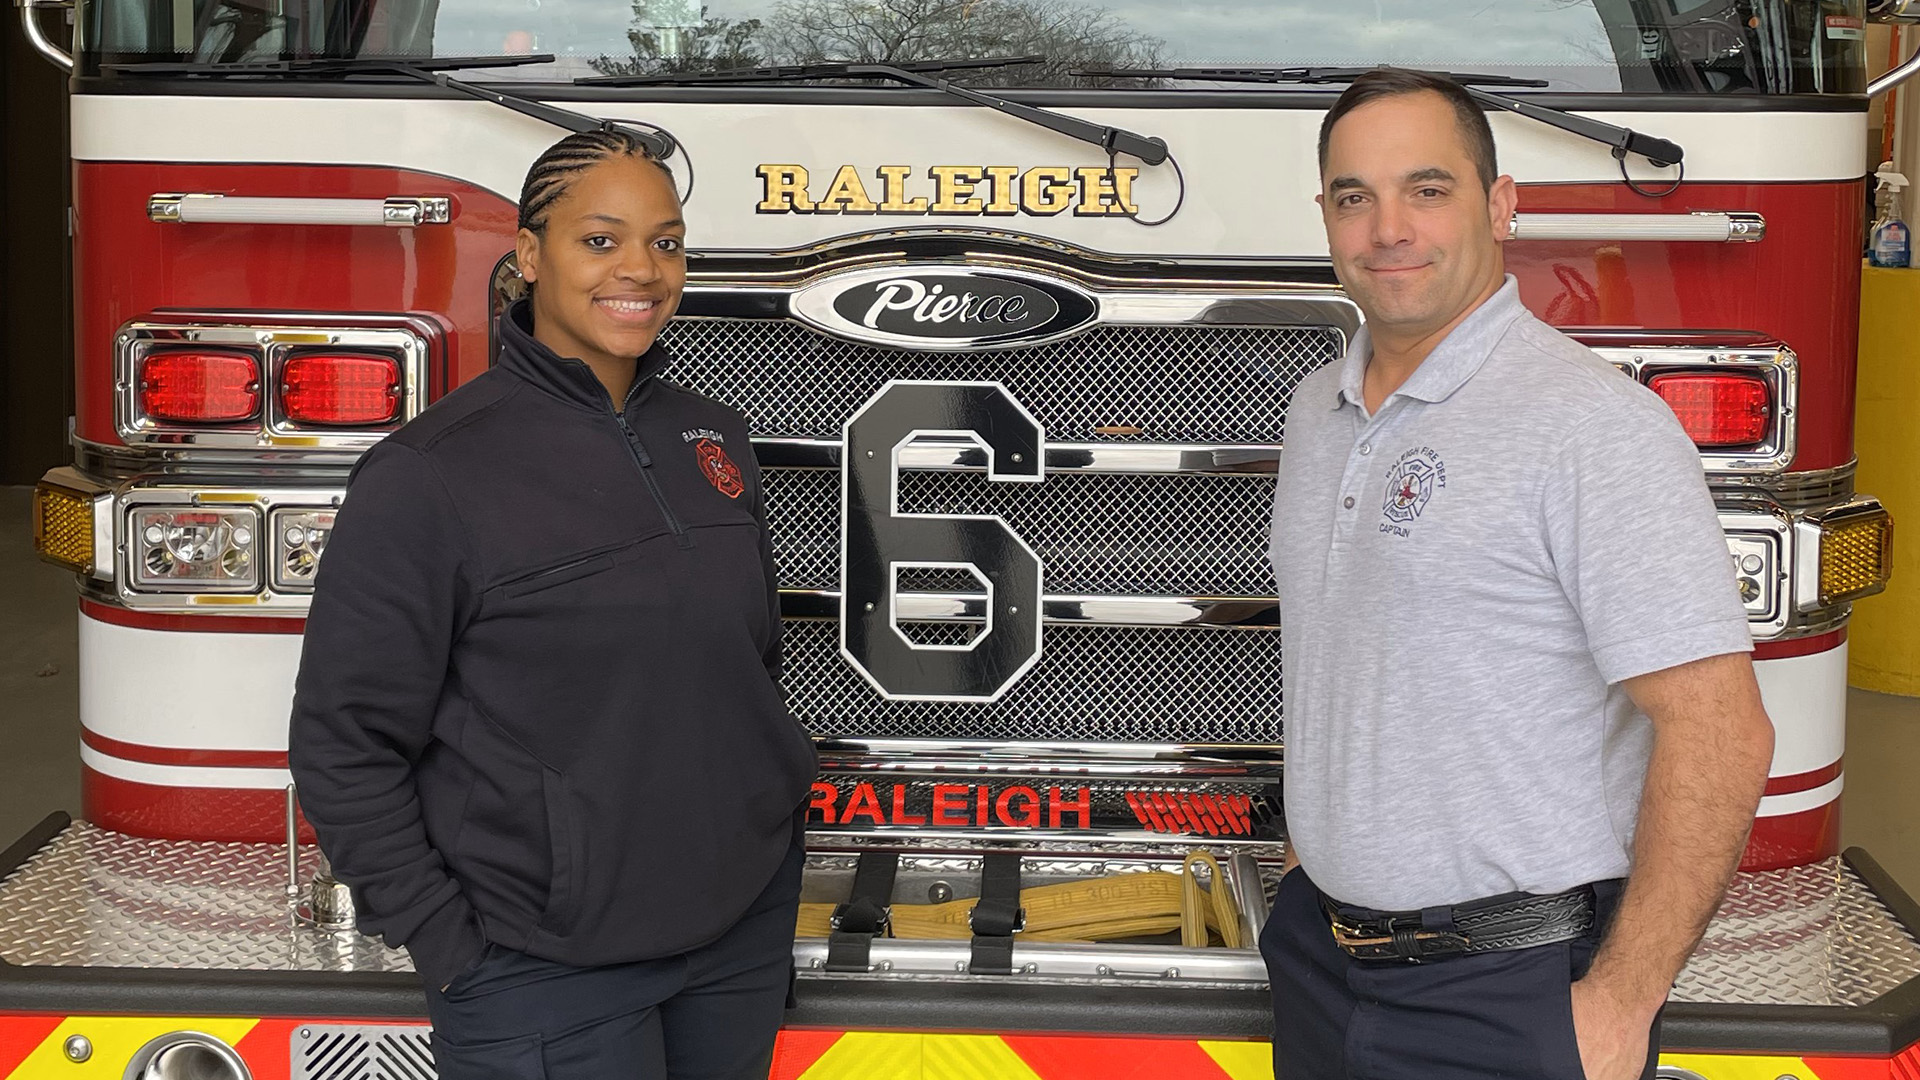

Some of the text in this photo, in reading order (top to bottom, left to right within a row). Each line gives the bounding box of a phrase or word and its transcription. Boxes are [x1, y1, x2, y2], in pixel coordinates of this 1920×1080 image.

[756, 164, 1139, 216] RALEIGH
[864, 279, 1028, 329] Pierce
[681, 428, 724, 443] RALEIGH
[1385, 446, 1445, 488] RALEIGH FIRE DEPT
[840, 379, 1045, 702] 6
[1379, 523, 1410, 537] CAPTAIN
[805, 782, 1091, 829] RALEIGH
[1134, 880, 1170, 897] PSI
